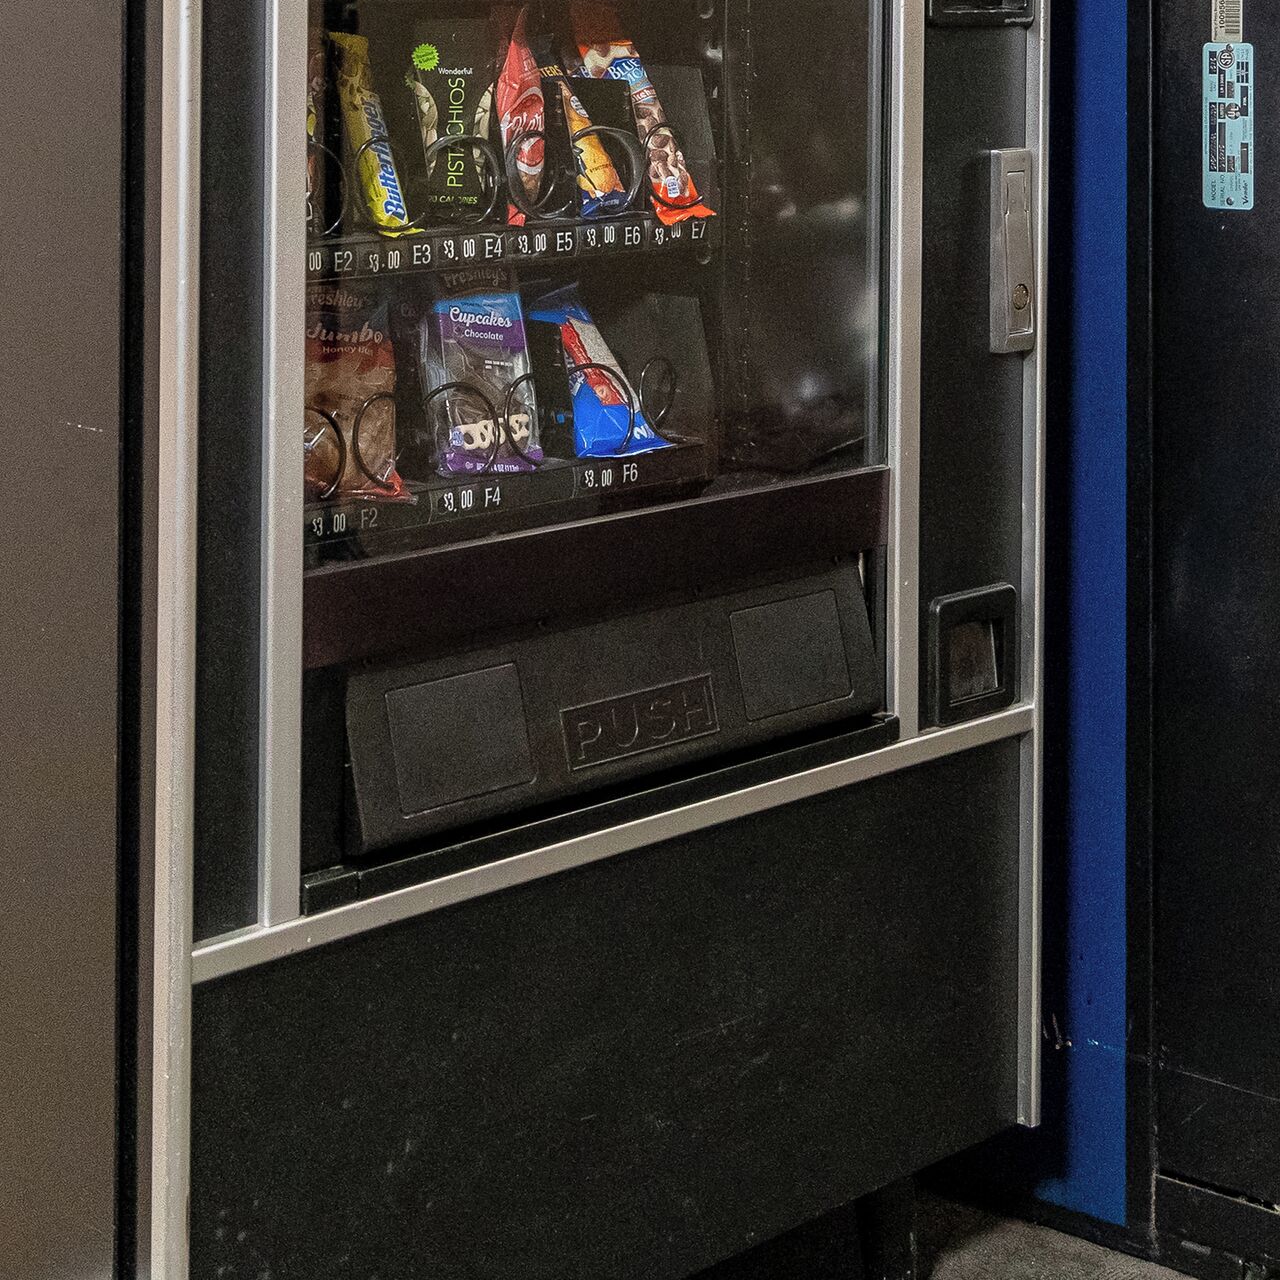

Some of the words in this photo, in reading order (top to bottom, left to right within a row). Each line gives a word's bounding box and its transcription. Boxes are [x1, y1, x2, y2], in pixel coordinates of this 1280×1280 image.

[437, 67, 473, 75] Wonderful
[624, 226, 641, 246] E6
[691, 221, 707, 239] E7
[485, 238, 503, 259] E4
[556, 231, 573, 252] E5
[334, 250, 353, 273] E2
[413, 244, 431, 266] E3
[449, 306, 513, 329] Cupcakes
[464, 328, 505, 342] Chocolate
[622, 462, 639, 483] F6
[484, 486, 502, 508] F4
[361, 507, 379, 529] F2
[573, 682, 717, 761] PUSH
